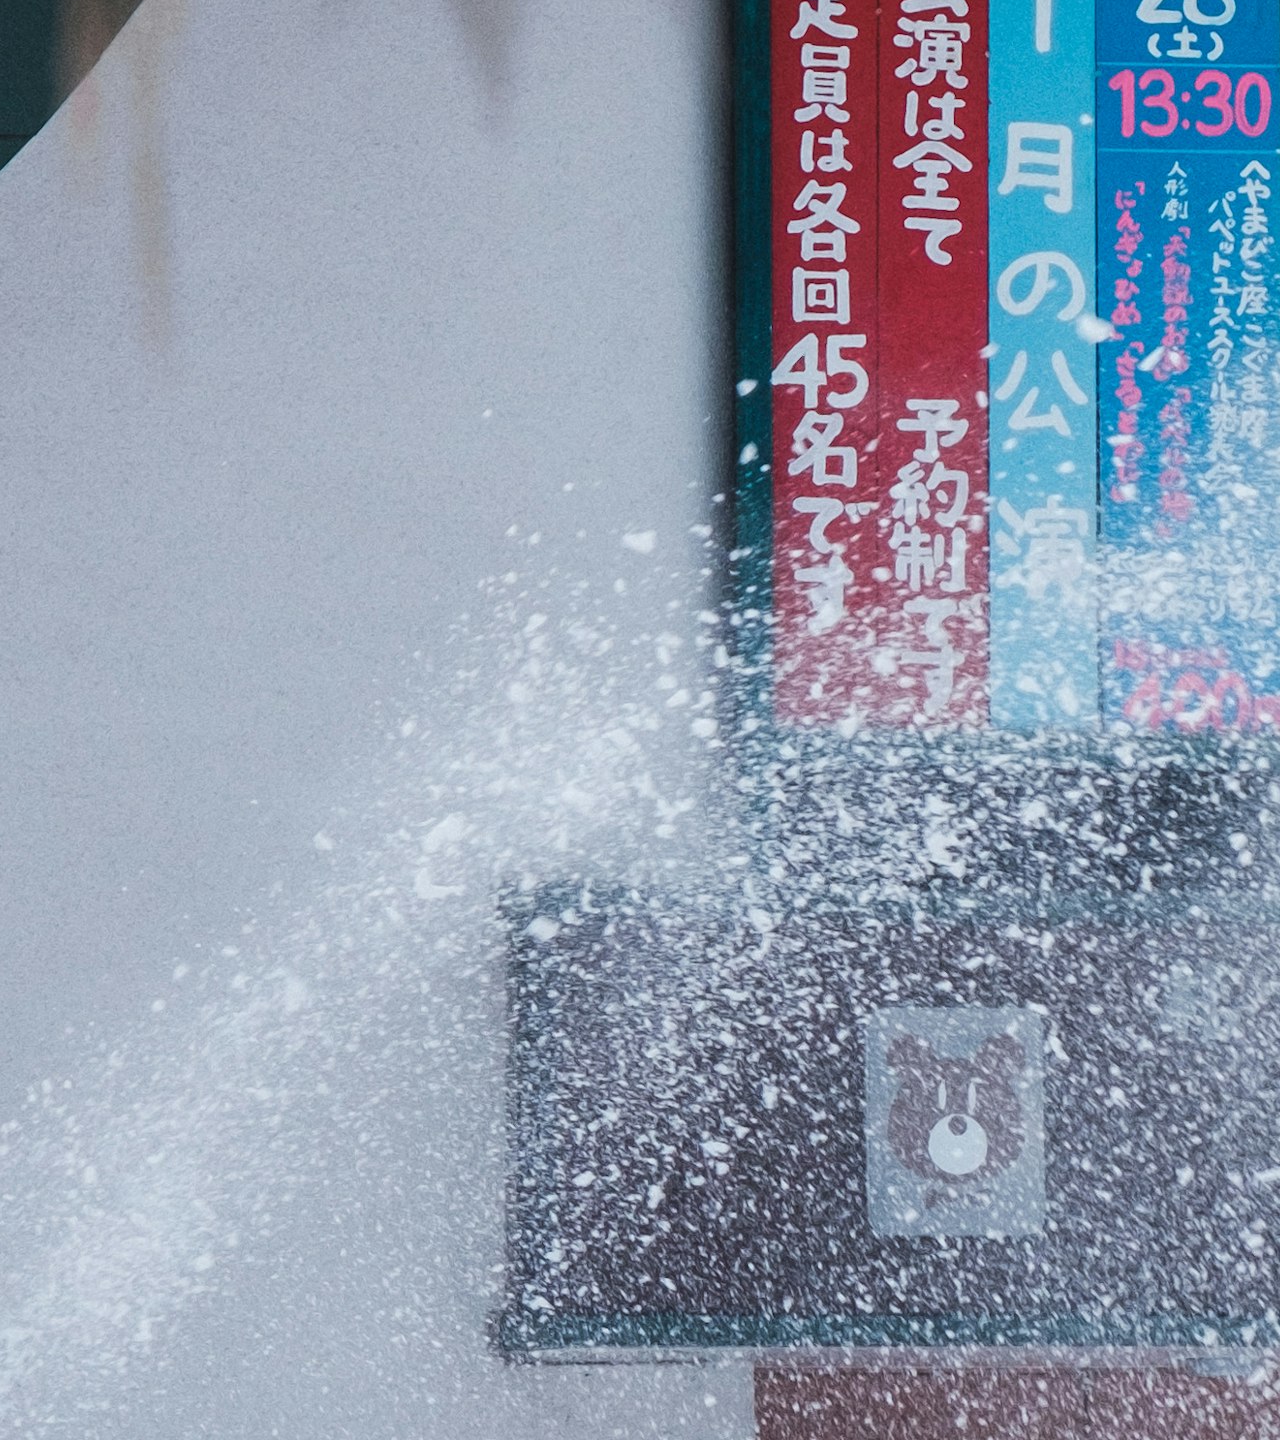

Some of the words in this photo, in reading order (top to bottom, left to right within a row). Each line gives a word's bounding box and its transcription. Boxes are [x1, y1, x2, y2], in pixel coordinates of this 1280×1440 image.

[1147, 26, 1224, 61] (土)
[1108, 69, 1271, 138] 13:30
[1161, 160, 1189, 221] 人形劇
